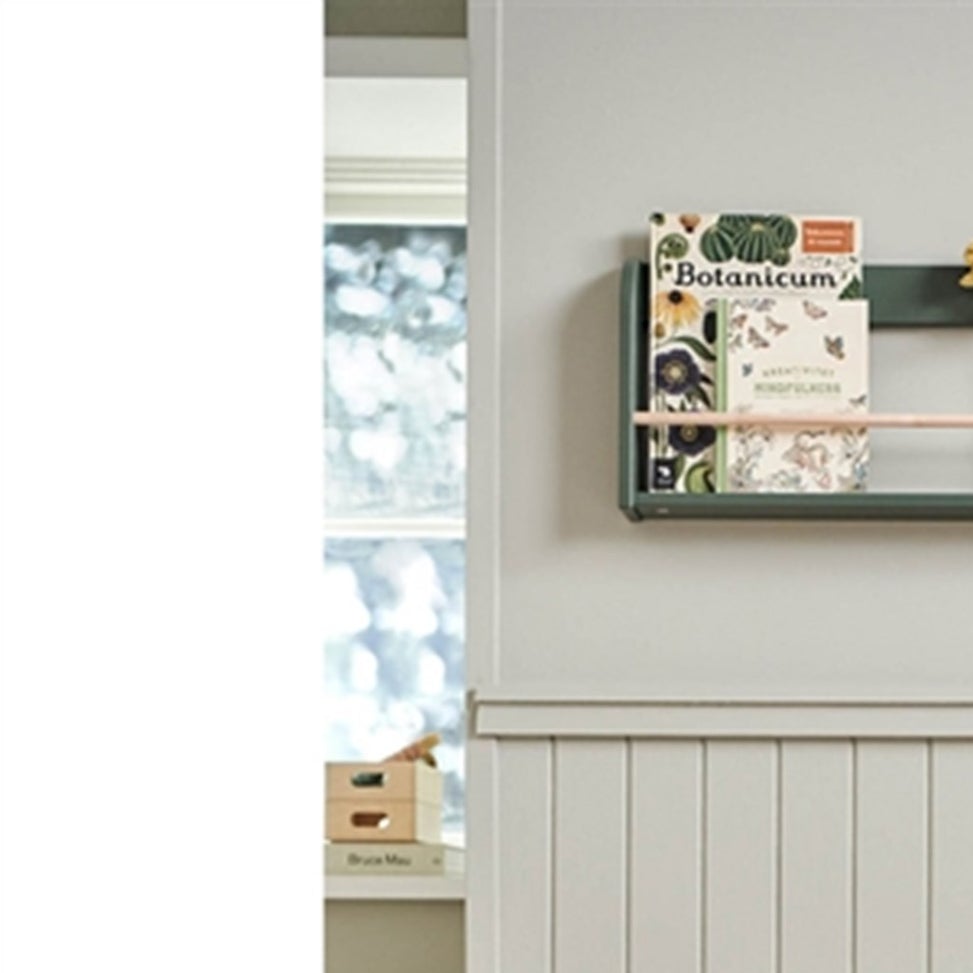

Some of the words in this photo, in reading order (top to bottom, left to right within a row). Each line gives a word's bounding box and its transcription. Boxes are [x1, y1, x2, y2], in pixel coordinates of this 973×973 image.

[674, 261, 837, 289] Botanicum
[347, 852, 383, 866] Bruce
[385, 853, 412, 866] Mau
